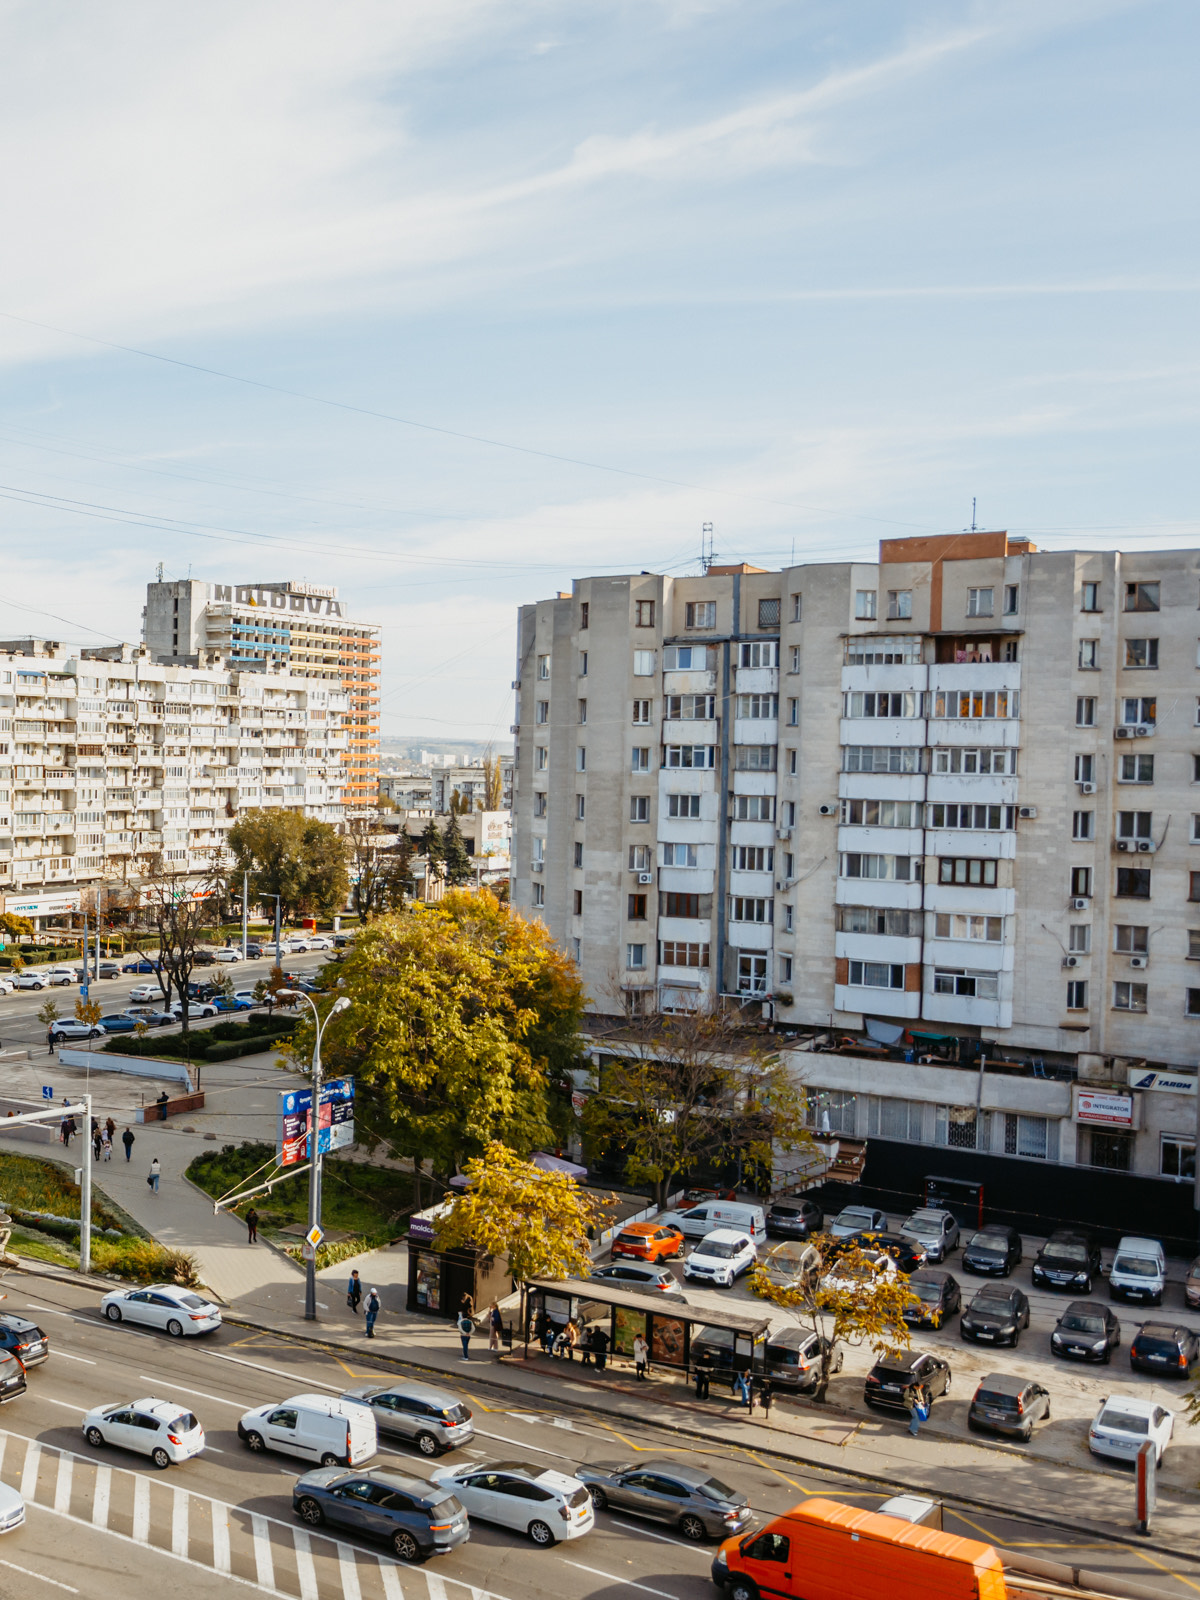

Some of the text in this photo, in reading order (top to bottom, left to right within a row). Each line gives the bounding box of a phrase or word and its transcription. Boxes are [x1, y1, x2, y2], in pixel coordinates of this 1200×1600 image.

[214, 583, 342, 617] MOLDOVA
[1158, 1080, 1192, 1089] TAROM
[1092, 1103, 1129, 1112] INTEGRATOR
[410, 1223, 438, 1234] moldce
